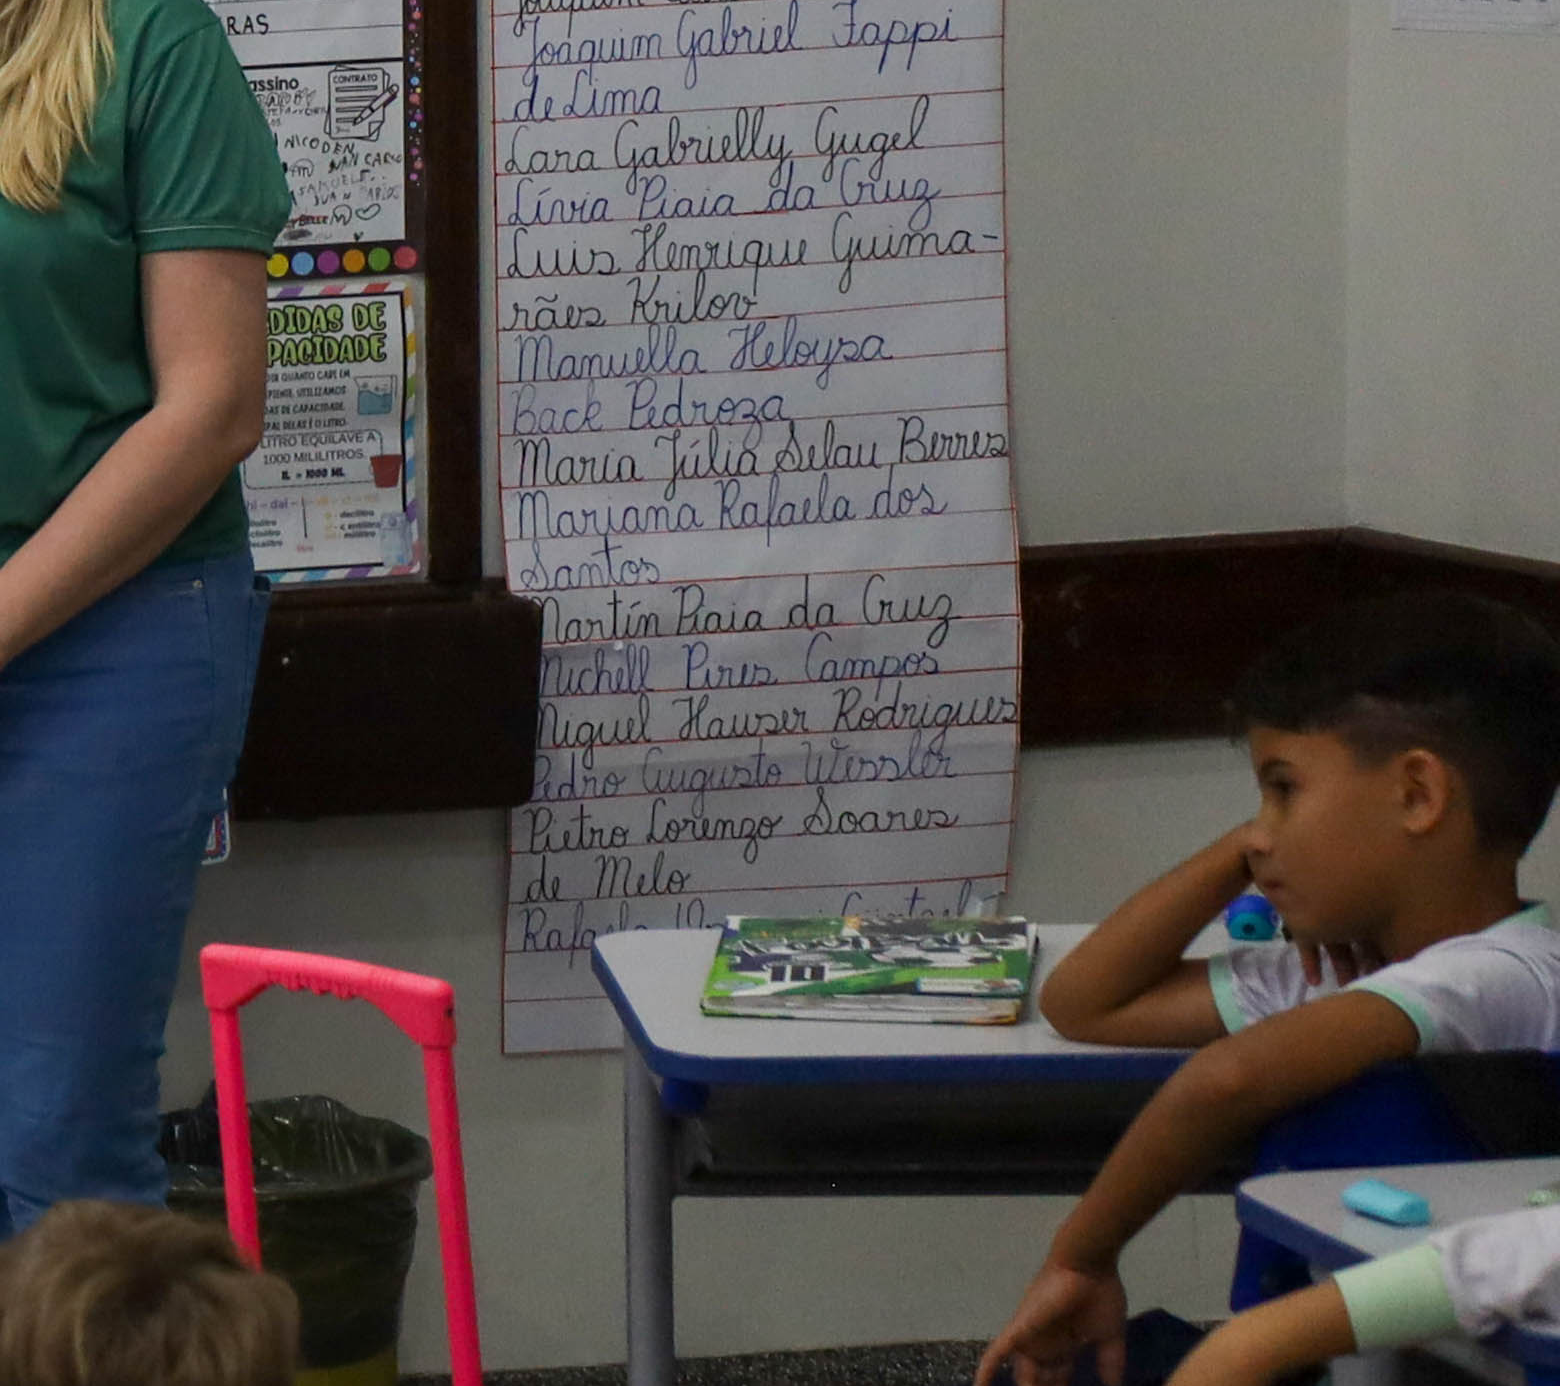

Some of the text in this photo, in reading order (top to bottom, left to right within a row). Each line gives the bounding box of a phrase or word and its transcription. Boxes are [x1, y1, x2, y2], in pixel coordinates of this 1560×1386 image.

[332, 74, 378, 84] CONTRATO
[352, 301, 387, 331] DE
[267, 333, 387, 368] PACIDADE
[516, 440, 643, 486] Maria
